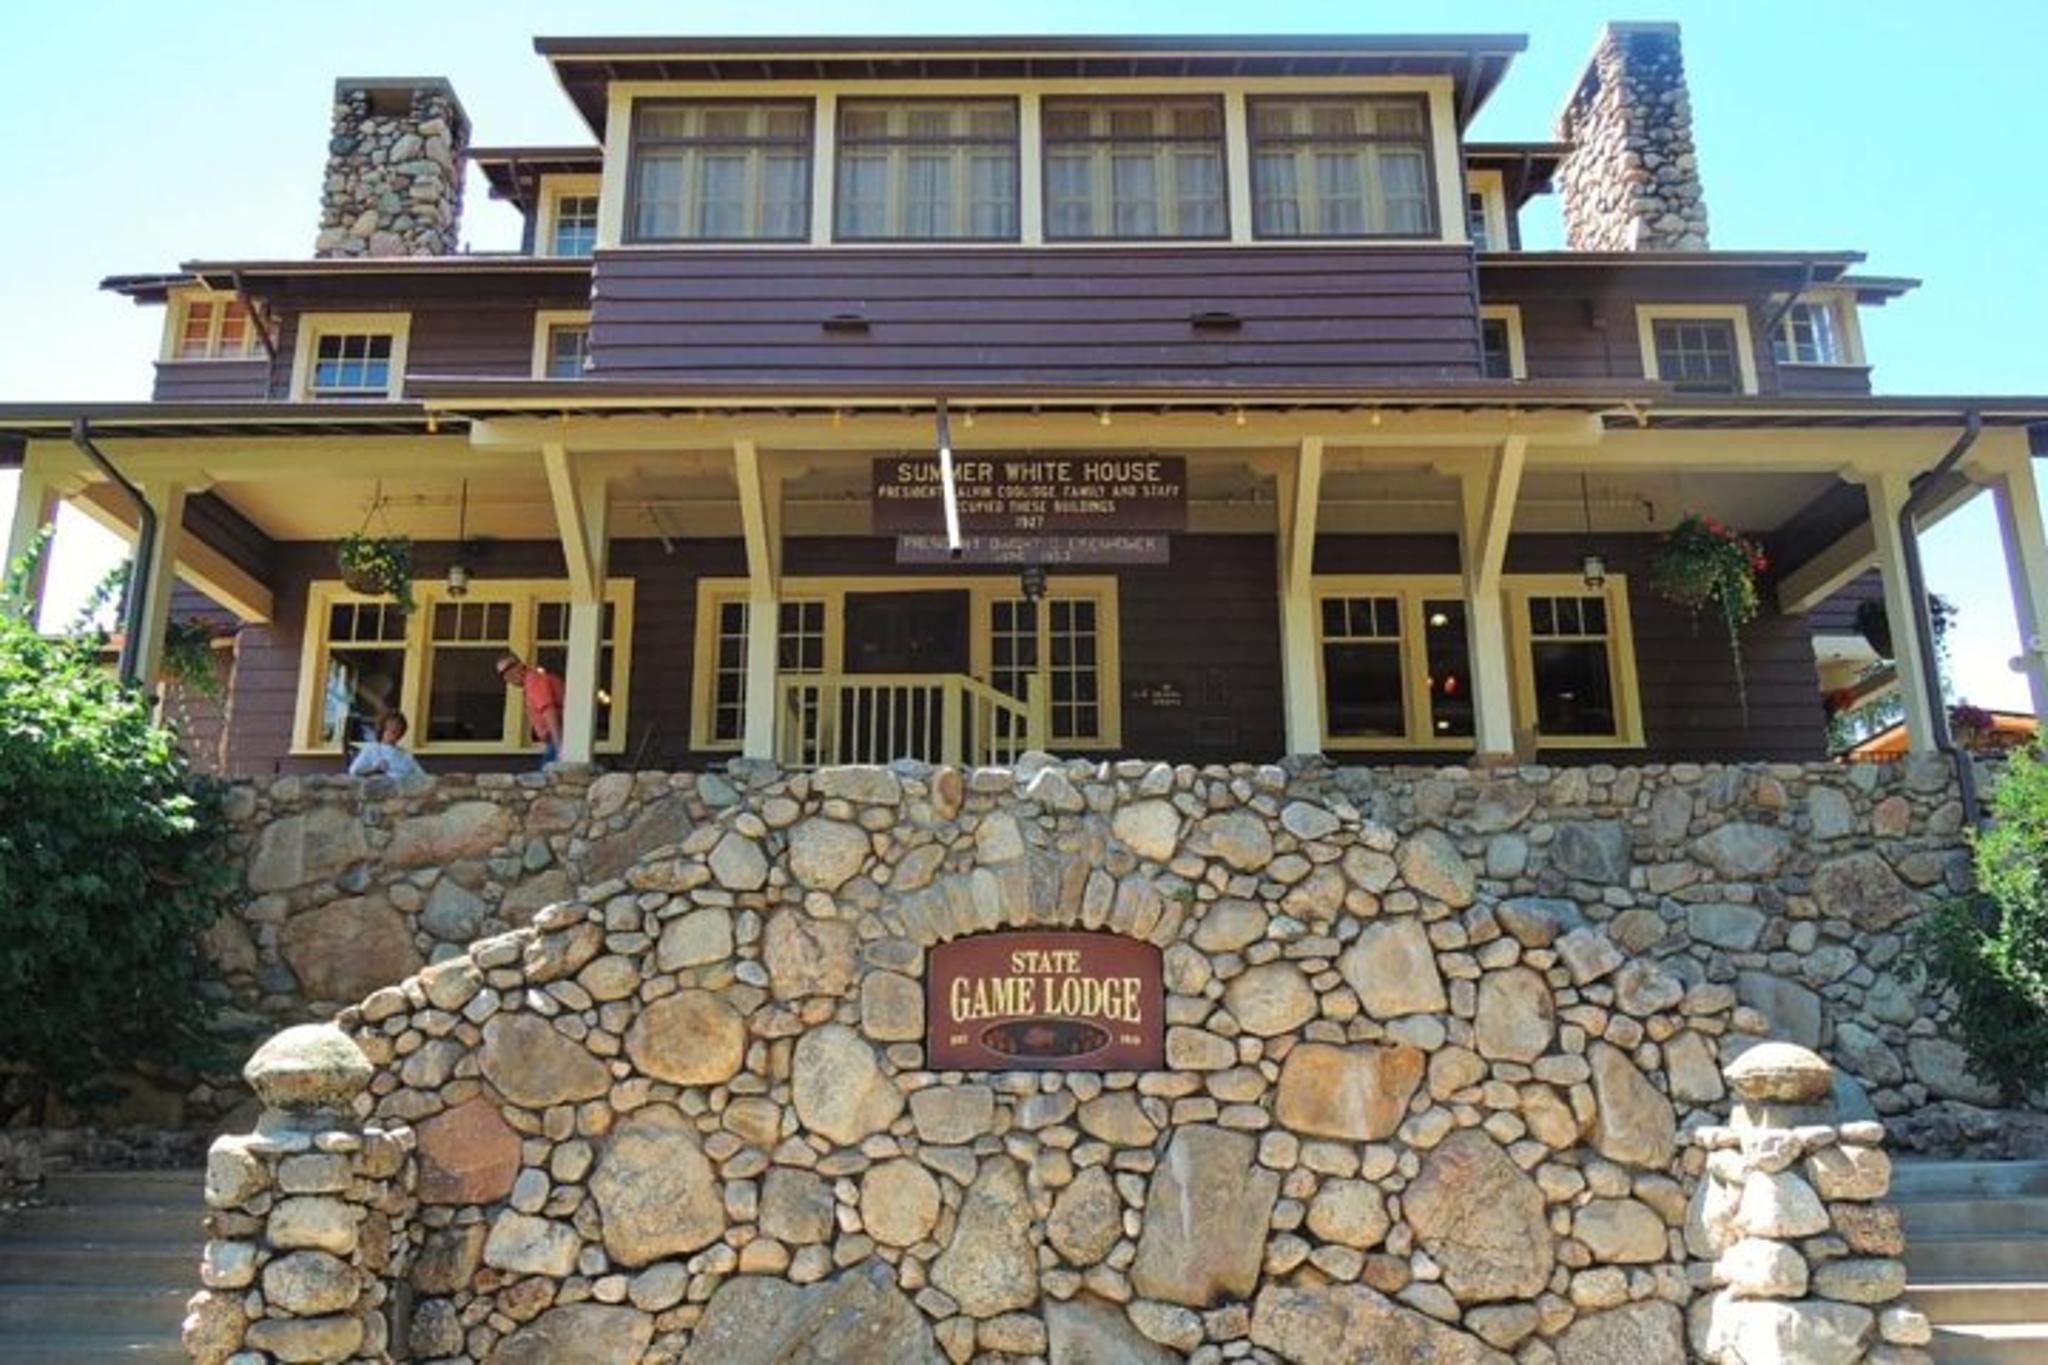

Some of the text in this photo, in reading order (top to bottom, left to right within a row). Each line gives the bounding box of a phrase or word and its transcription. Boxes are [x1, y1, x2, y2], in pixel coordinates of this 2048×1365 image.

[1005, 461, 1072, 482] WHITE
[1082, 460, 1162, 482] HOUSE
[877, 485, 945, 499] PRESIDENT
[997, 485, 1056, 499] COOLIDGE
[1111, 484, 1137, 498] AND
[1141, 484, 1181, 498] STAFF
[1053, 498, 1117, 514] BUILDINGS
[1011, 950, 1081, 974] STATE
[950, 977, 1142, 1024] GAME LODGE
